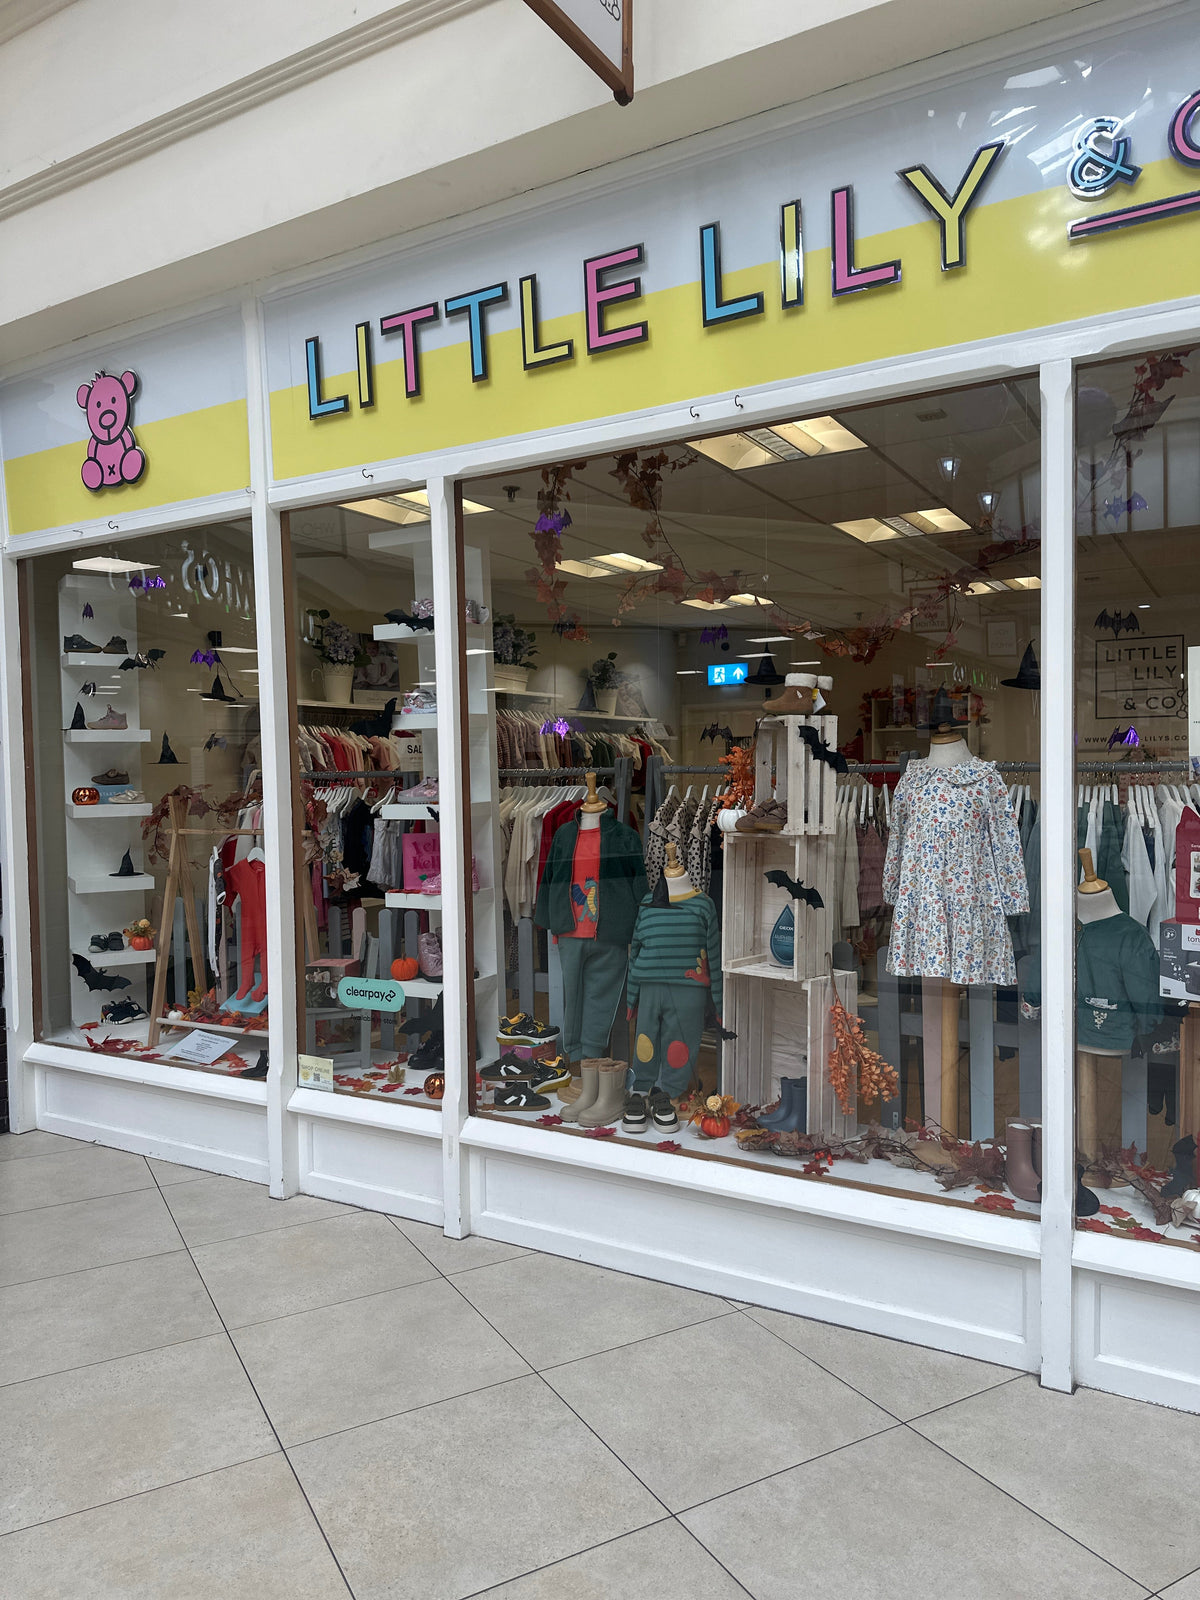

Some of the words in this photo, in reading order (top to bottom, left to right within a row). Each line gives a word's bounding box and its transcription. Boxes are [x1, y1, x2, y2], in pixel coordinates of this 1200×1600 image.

[304, 242, 649, 421] LITTLE
[699, 140, 1006, 327] LILY
[1066, 115, 1143, 198] &
[1105, 645, 1177, 662] LITTLE
[1134, 665, 1177, 680] LILY
[1123, 697, 1137, 711] &
[1145, 696, 1177, 709] CO
[407, 744, 423, 754] SAL
[346, 986, 386, 1002] clearpay
